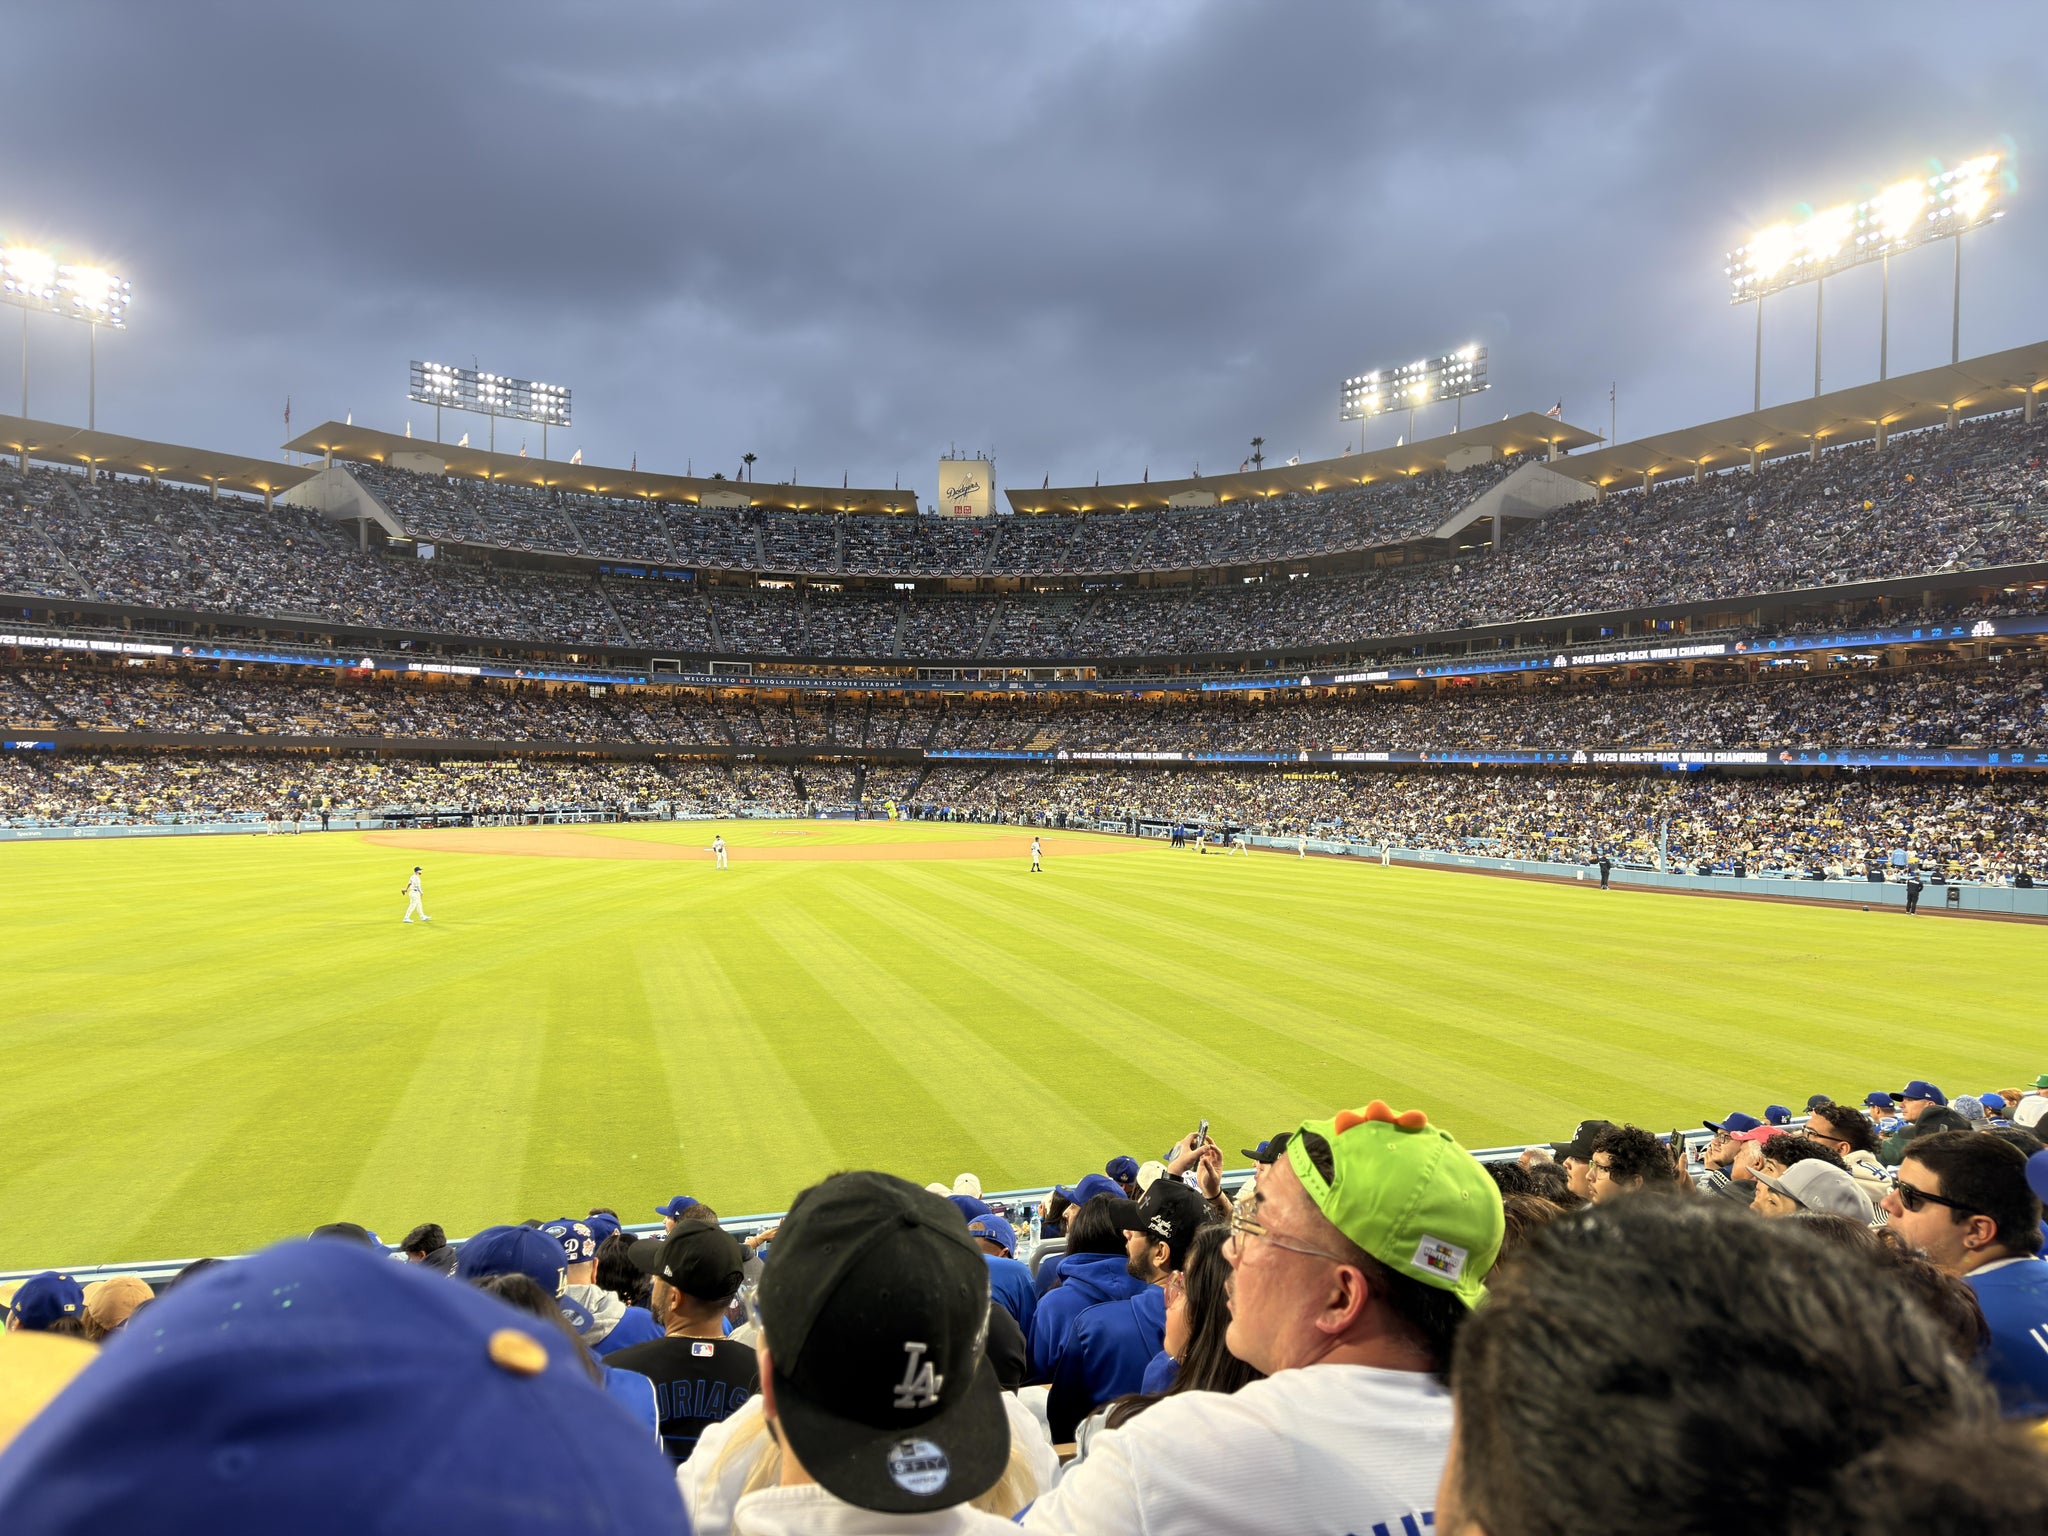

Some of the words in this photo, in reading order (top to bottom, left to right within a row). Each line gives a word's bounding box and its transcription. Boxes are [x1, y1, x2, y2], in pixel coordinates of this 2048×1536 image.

[946, 482, 981, 499] Dodgers
[19, 636, 88, 648] BACK-TO-BACK
[89, 641, 122, 651] WORLD
[123, 643, 173, 654] CHAMPIONS
[1572, 654, 1594, 664] 24/25
[1595, 650, 1648, 663] BACK-TO-BACK
[1650, 648, 1677, 659] WORLD
[1679, 644, 1725, 656] CHAMPIONS
[1153, 752, 1182, 760] CHAMPIONS
[1593, 753, 1618, 762] 24/25
[1619, 752, 1680, 762] BACK-TO-BACK
[1681, 752, 1712, 762] WORLD
[1714, 752, 1767, 762] CHAMPIONS
[893, 1341, 944, 1408] LA
